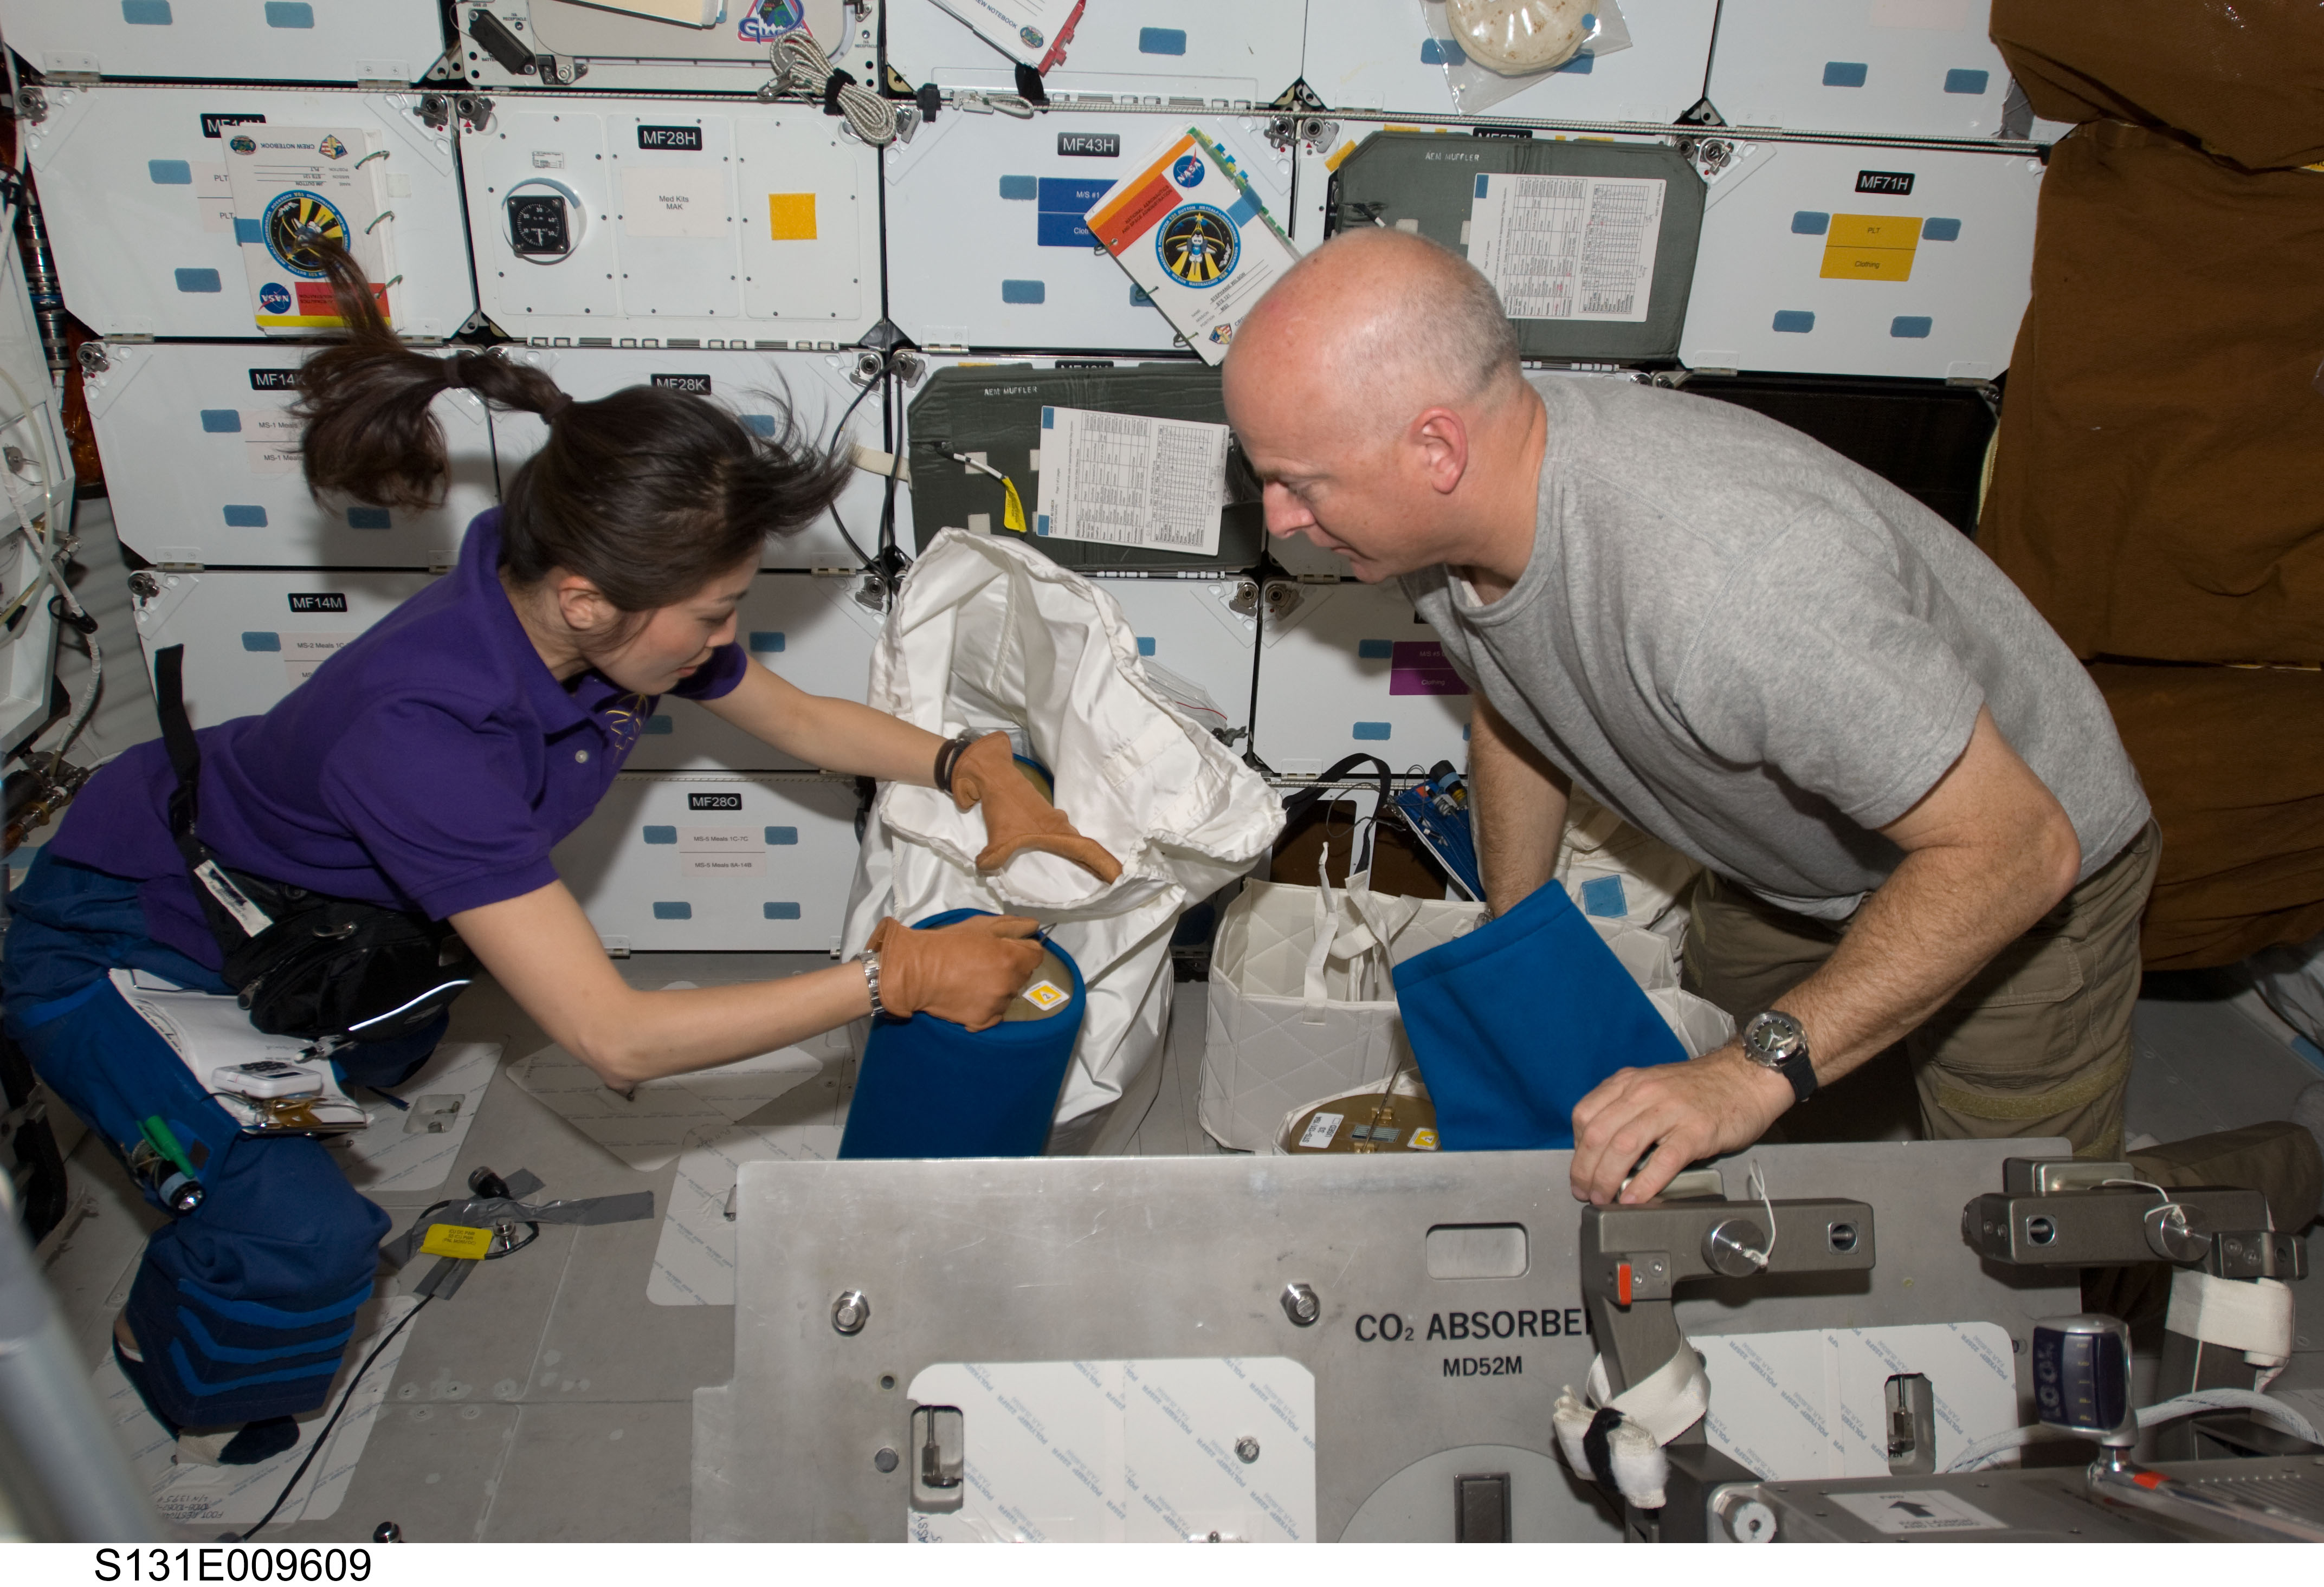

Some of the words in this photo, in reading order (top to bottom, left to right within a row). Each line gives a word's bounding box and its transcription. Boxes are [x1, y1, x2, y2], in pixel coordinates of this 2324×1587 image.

[987, 5, 1018, 29] NOTEBOOK
[643, 131, 696, 145] MF28H
[1063, 138, 1114, 152] MF43H
[1425, 152, 1441, 160] AEM
[1445, 153, 1480, 161] MUFFLER
[1177, 161, 1202, 183] NASA
[1861, 176, 1909, 190] MF71H
[1855, 261, 1880, 269] Clothing
[1210, 284, 1231, 303] STEPHANIE
[1231, 272, 1246, 288] WILSON
[261, 294, 289, 302] NASA
[656, 378, 706, 390] MF28K
[984, 387, 1000, 396] AEM
[1003, 386, 1038, 394] MUFFLER
[293, 598, 343, 608] MF14M
[1302, 1116, 1322, 1143] STS-131/19A
[1325, 1125, 1337, 1138] USED
[1443, 1356, 1523, 1377] MD52M
[201, 1511, 224, 1519] FOOT
